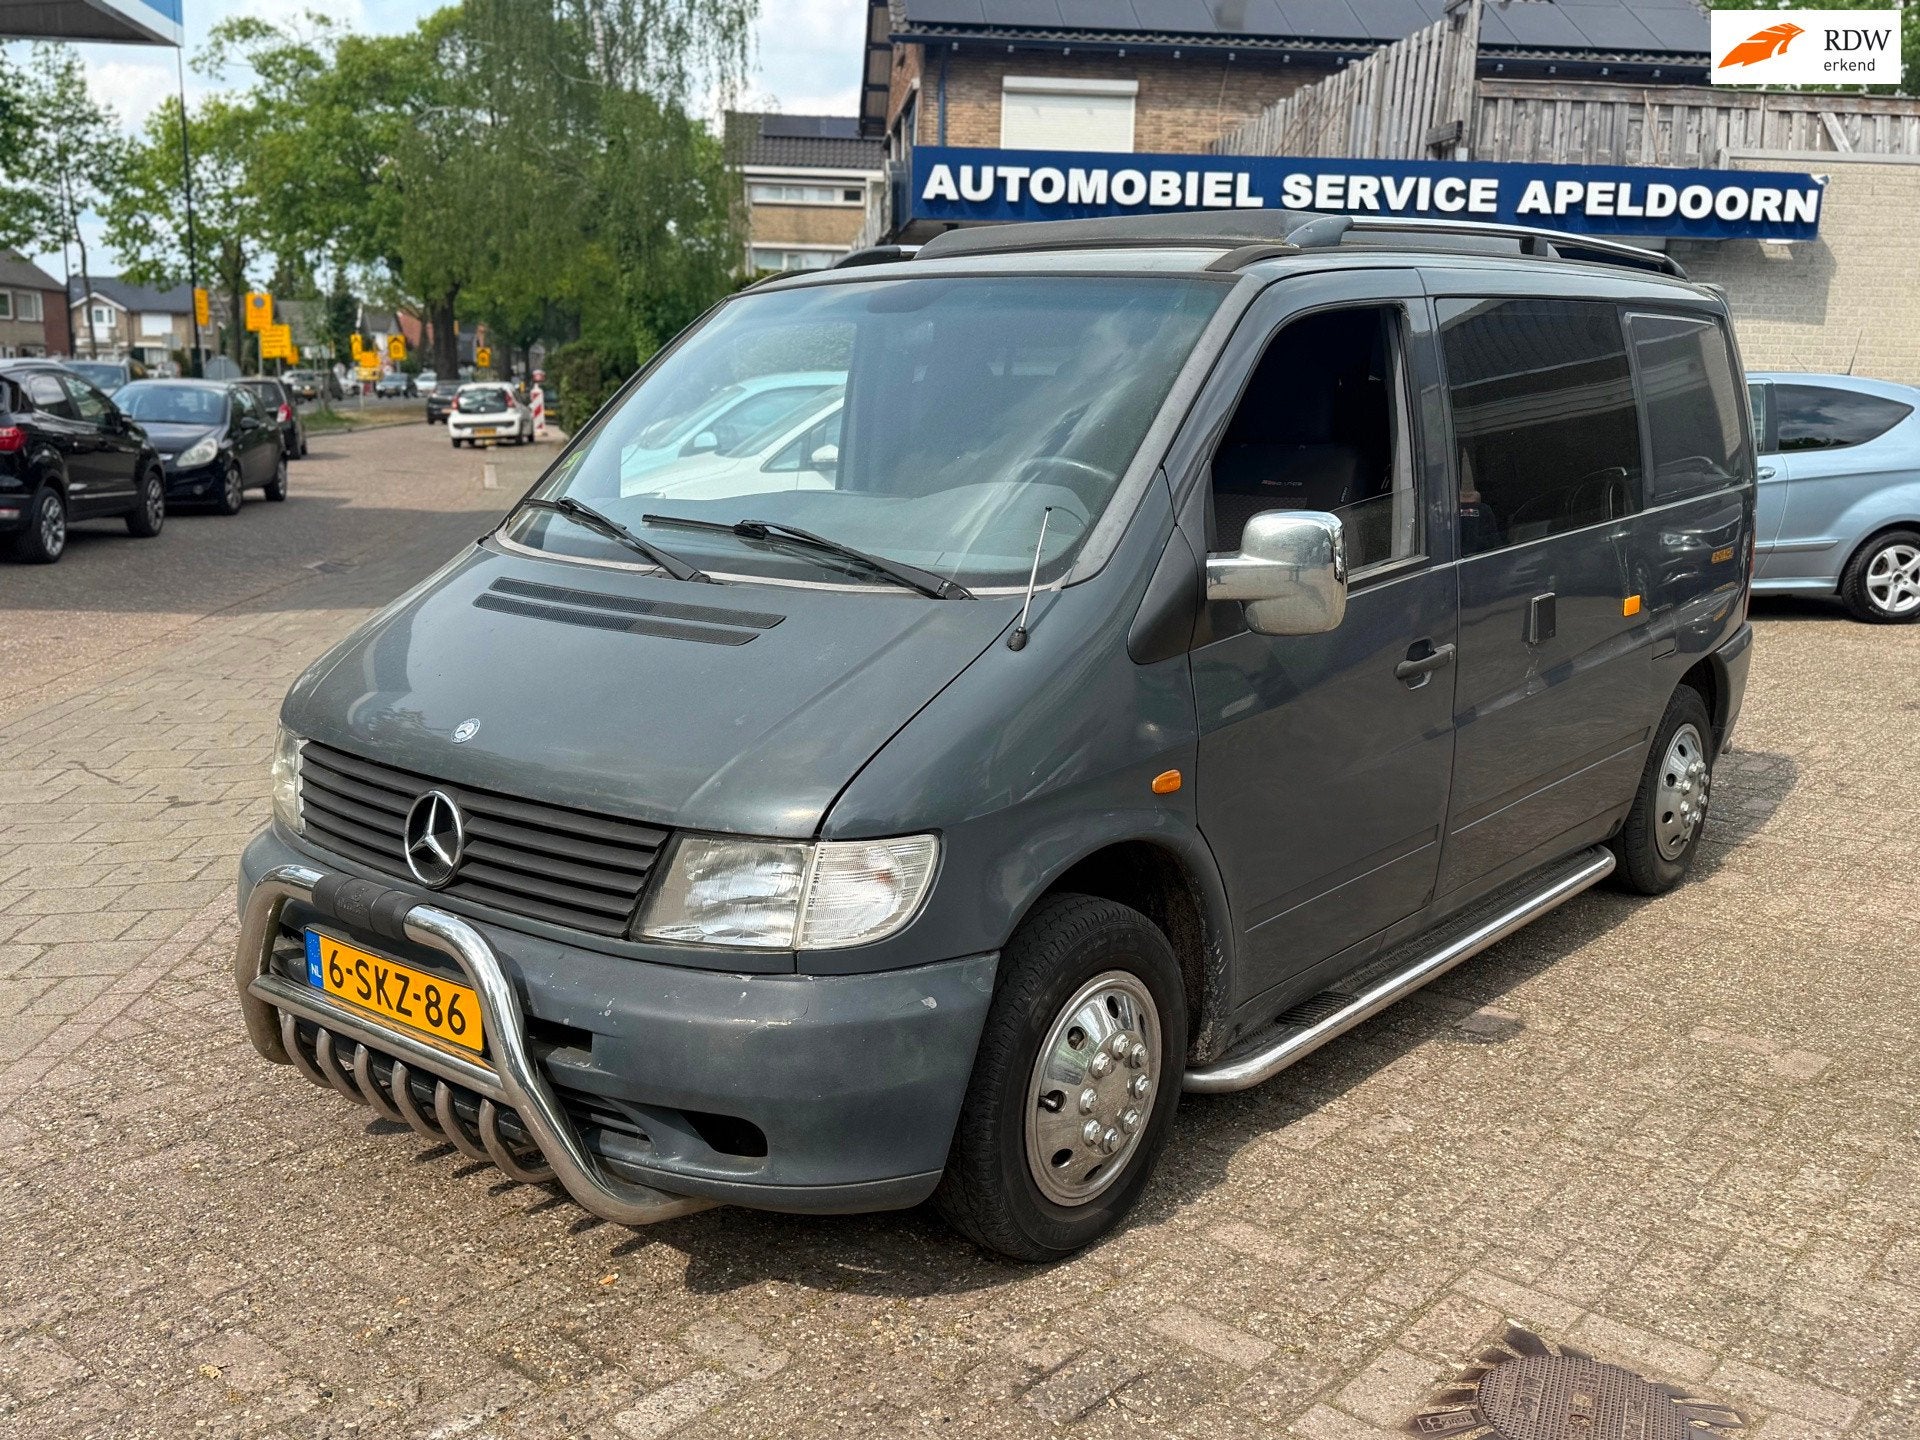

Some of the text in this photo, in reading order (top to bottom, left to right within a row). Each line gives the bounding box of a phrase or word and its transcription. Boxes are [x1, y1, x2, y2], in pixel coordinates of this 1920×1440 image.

[921, 164, 1819, 223] AUTOMOBIEL SERVICE APELDOORN
[310, 949, 467, 1036] NL 6-SKZ-86
